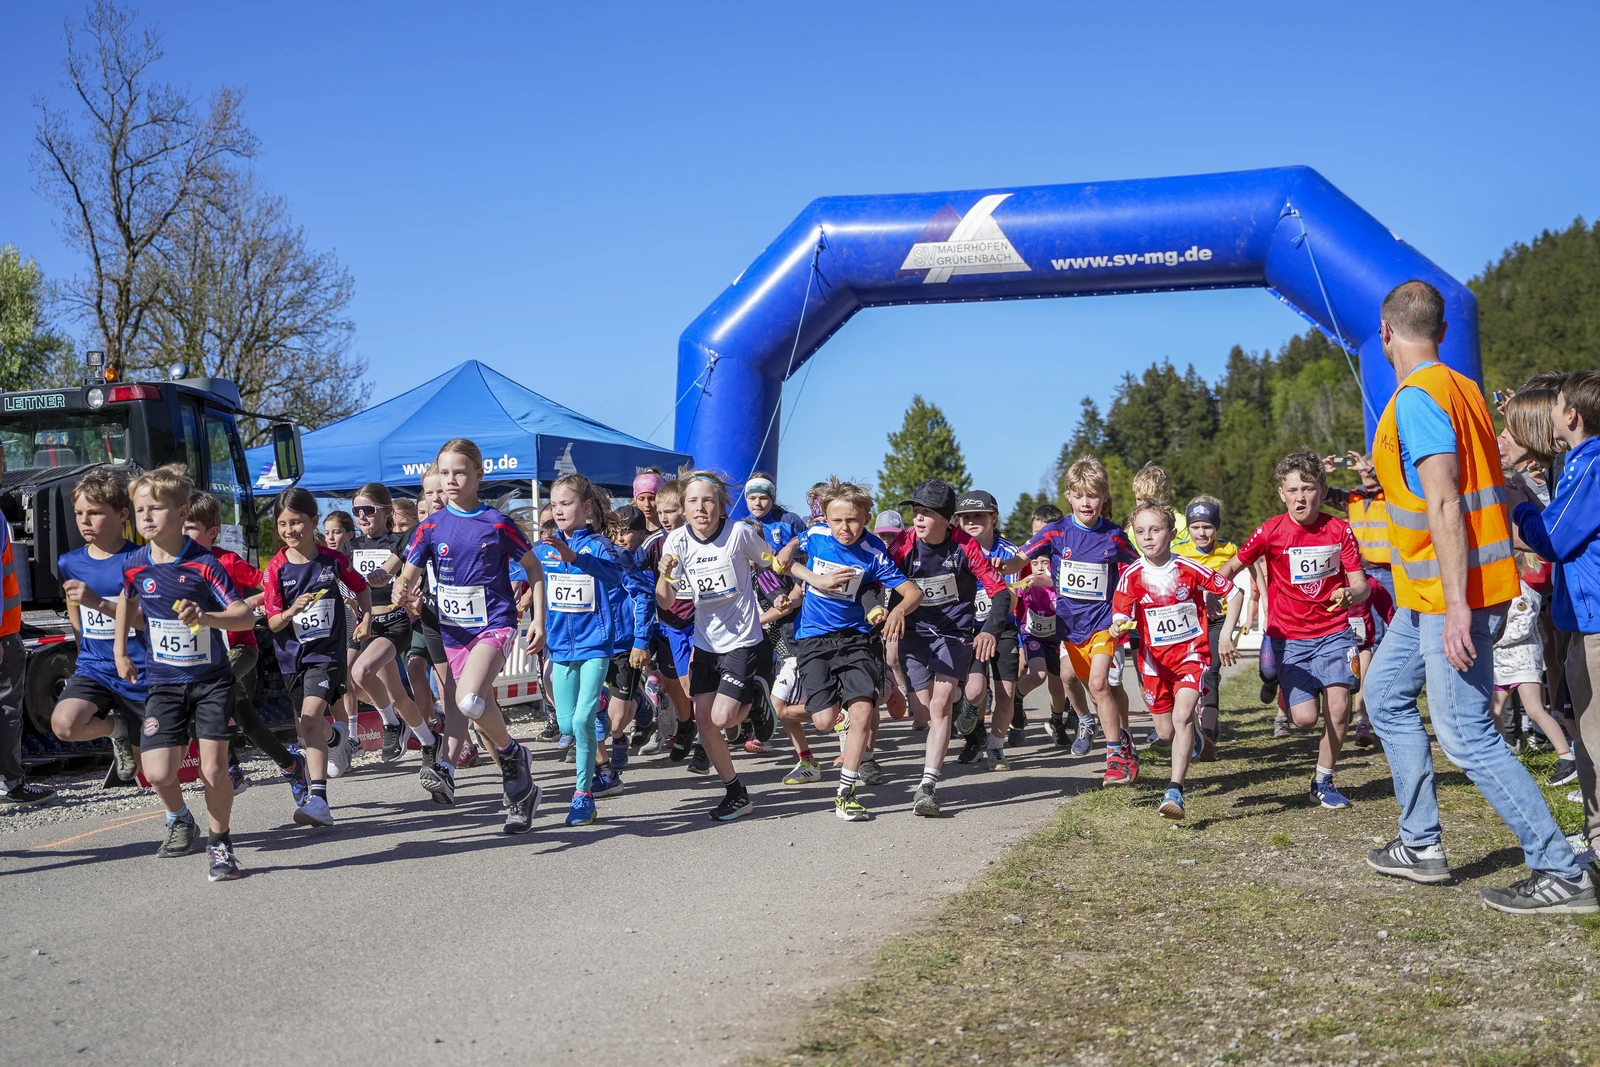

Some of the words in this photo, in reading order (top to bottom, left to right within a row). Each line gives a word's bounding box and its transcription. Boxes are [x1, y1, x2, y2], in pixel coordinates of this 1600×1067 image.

[913, 246, 937, 267] SV
[937, 242, 1009, 254] MAIERHÖFEN
[936, 253, 1012, 266] GRÜNENBACH
[1051, 246, 1212, 270] www.sv-mg.de
[4, 394, 65, 411] LEITNER
[360, 560, 387, 573] 69-
[1300, 556, 1331, 573] 61-1
[283, 579, 296, 587] JAKO
[697, 573, 727, 593] 82-1
[1067, 573, 1099, 590] 96-1
[555, 586, 583, 601] 67-1
[443, 598, 474, 615] 93-1
[87, 611, 113, 627] 84-
[301, 611, 330, 631] 85-1
[1157, 614, 1190, 634] 40-1
[159, 635, 198, 652] 45-1
